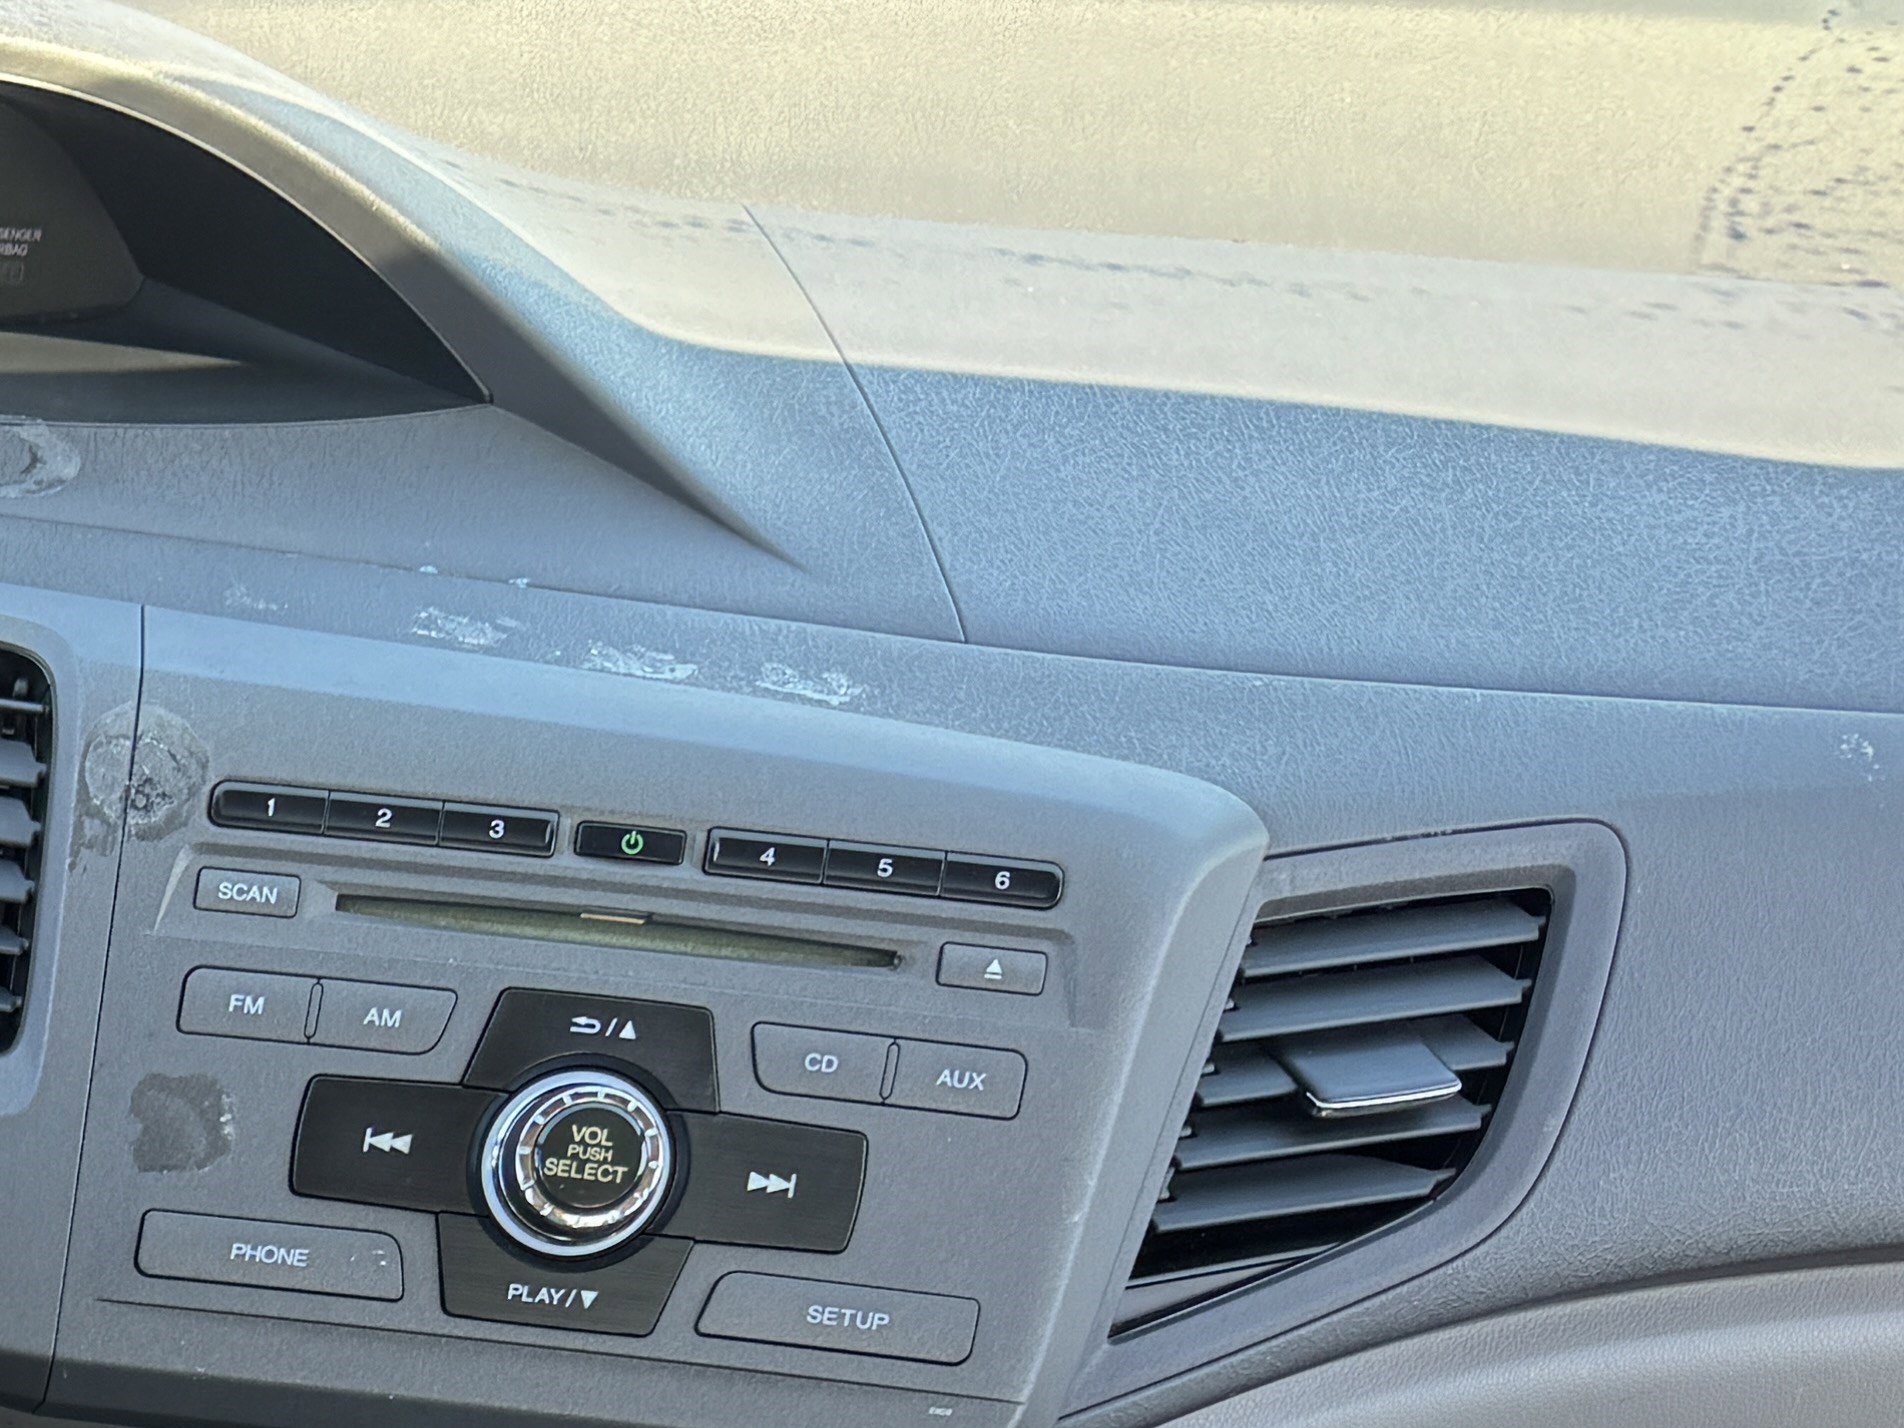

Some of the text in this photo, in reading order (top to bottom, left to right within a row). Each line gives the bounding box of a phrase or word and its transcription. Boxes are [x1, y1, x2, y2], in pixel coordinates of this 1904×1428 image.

[266, 797, 276, 817] 1
[375, 807, 393, 829] 2
[488, 819, 505, 839] 3
[758, 846, 777, 867] 4
[876, 858, 894, 878] 5
[993, 870, 1011, 890] 6
[217, 881, 279, 905] SCAN
[227, 993, 266, 1015] FM
[362, 1006, 403, 1028] AM
[803, 1052, 839, 1073] CD
[935, 1068, 987, 1091] AUX
[571, 1124, 614, 1147] VOL
[566, 1143, 614, 1163] PUSH
[543, 1157, 629, 1185] SELECT
[229, 1242, 311, 1268] PHONE
[806, 1304, 891, 1331] SETUP
